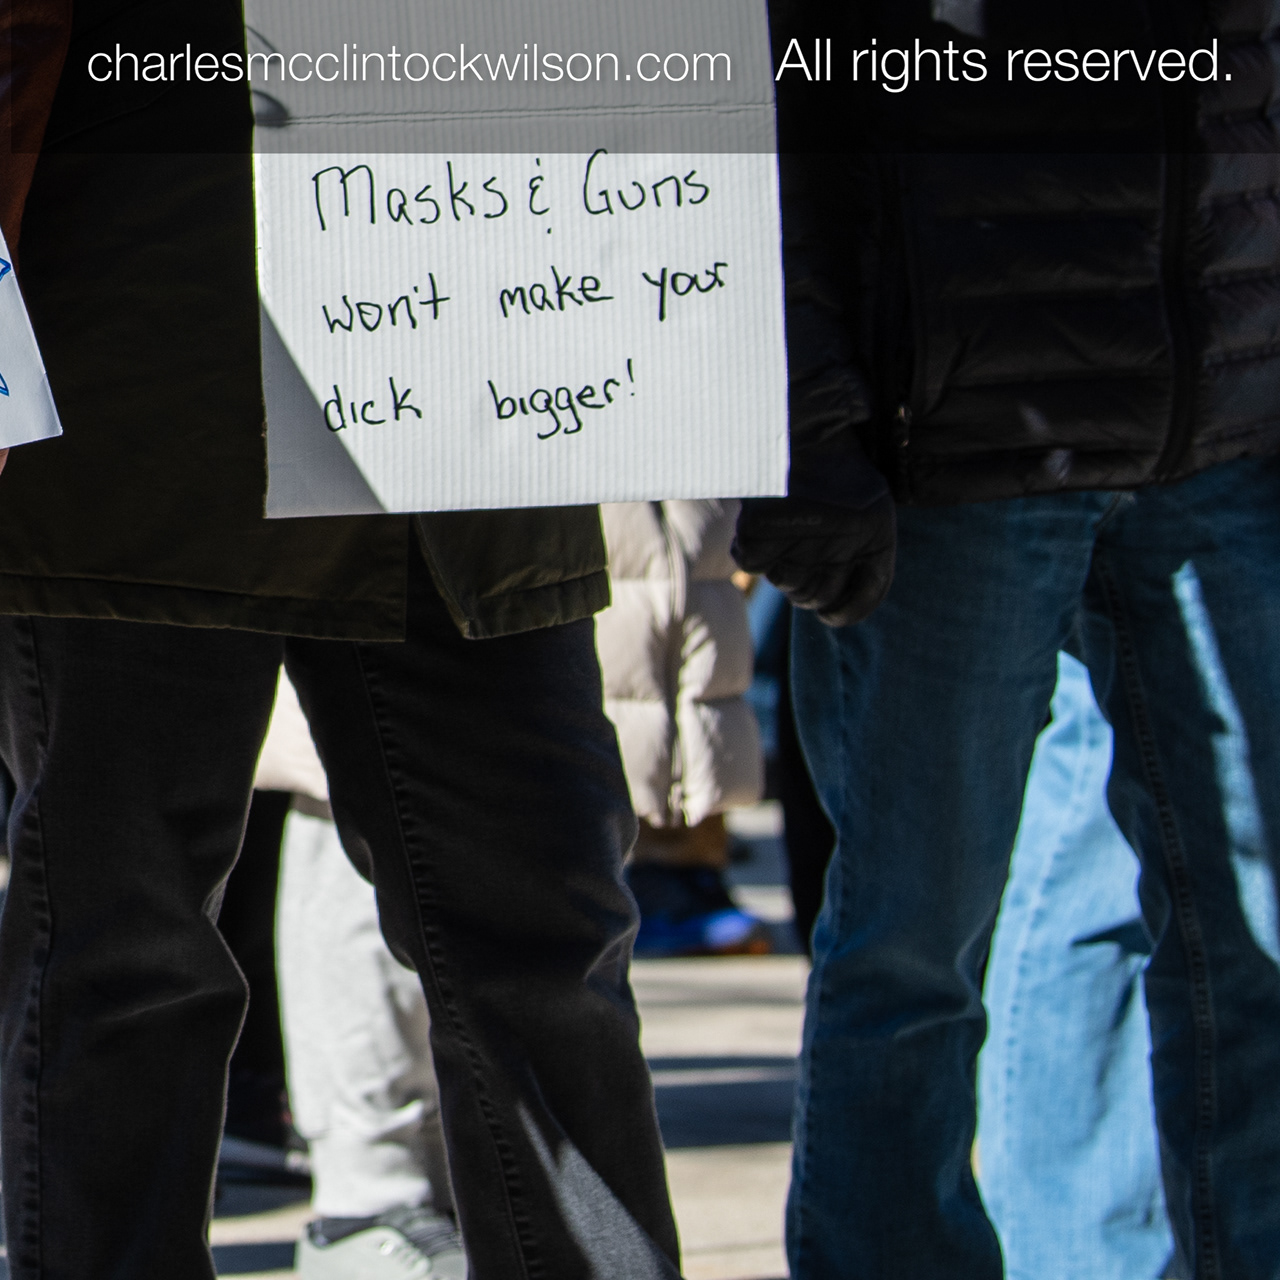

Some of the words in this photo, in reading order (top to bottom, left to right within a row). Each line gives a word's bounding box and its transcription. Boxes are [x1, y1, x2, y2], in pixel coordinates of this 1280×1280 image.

[312, 160, 508, 231] Masks
[584, 148, 710, 216] Guns
[323, 271, 451, 334] won't
[499, 265, 614, 318] make
[641, 261, 728, 322] your
[323, 376, 423, 433] dick
[487, 357, 637, 440] bigger!
